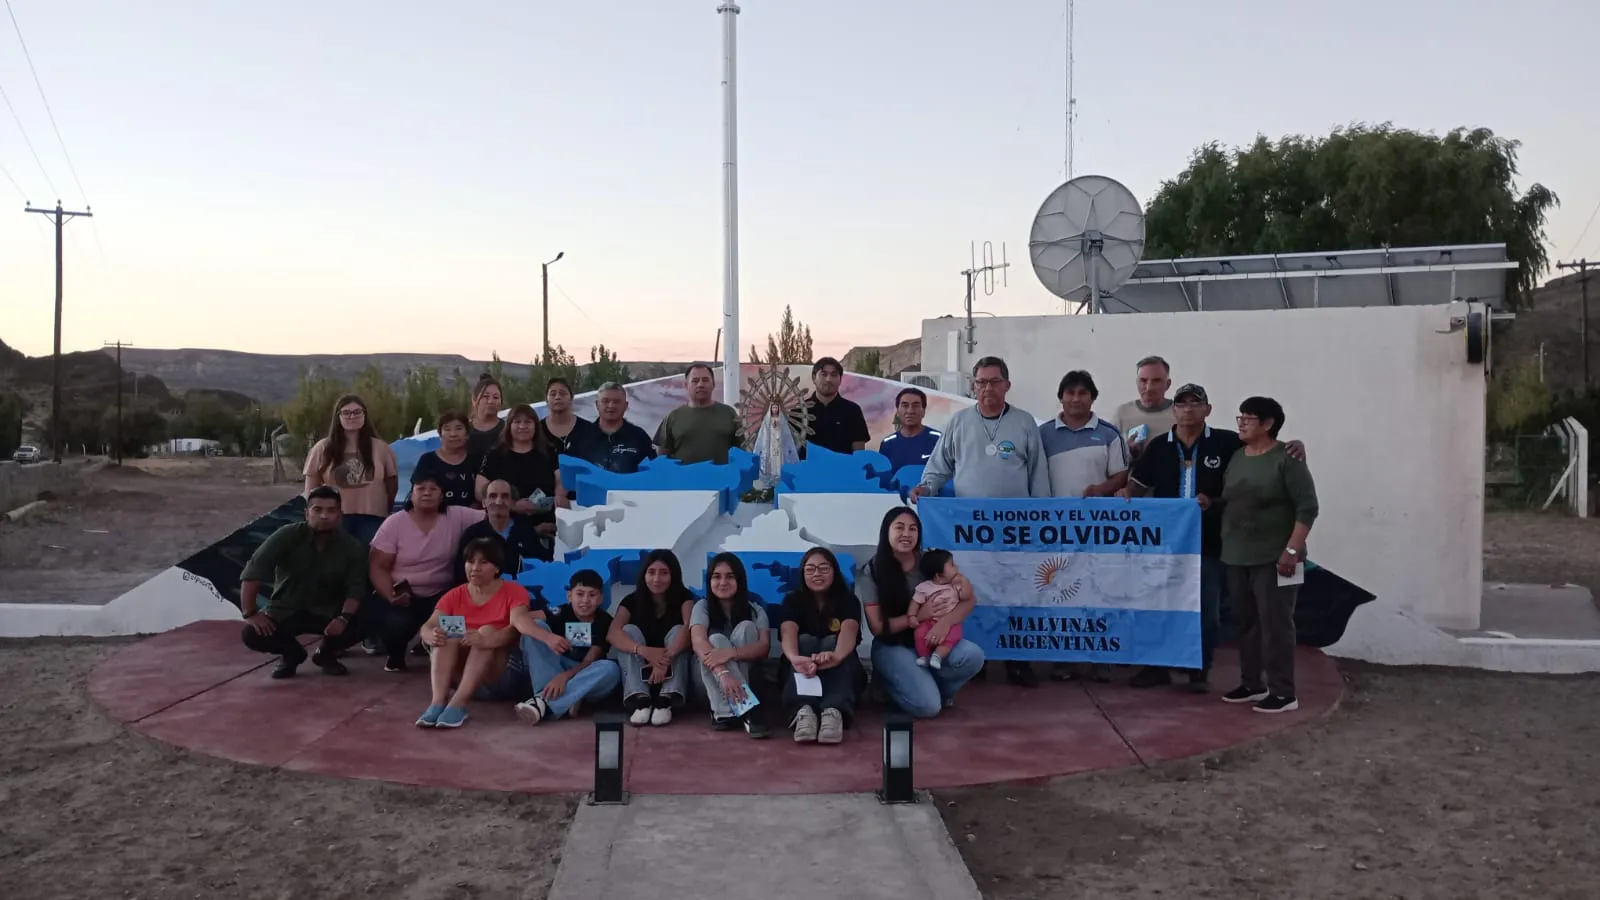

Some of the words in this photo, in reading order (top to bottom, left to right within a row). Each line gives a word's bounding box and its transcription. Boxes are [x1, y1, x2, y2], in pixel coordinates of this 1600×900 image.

[973, 510, 989, 521] EL
[993, 510, 1051, 522] HONOR
[1055, 510, 1064, 521] Y
[1069, 510, 1086, 521] EL
[1089, 509, 1142, 522] VALOR
[954, 525, 995, 544] NO
[1002, 525, 1031, 545] SE
[1039, 525, 1162, 547] OLVIDAN
[1008, 616, 1108, 633] MALVINAS
[995, 633, 1121, 652] ARGENTINAS
